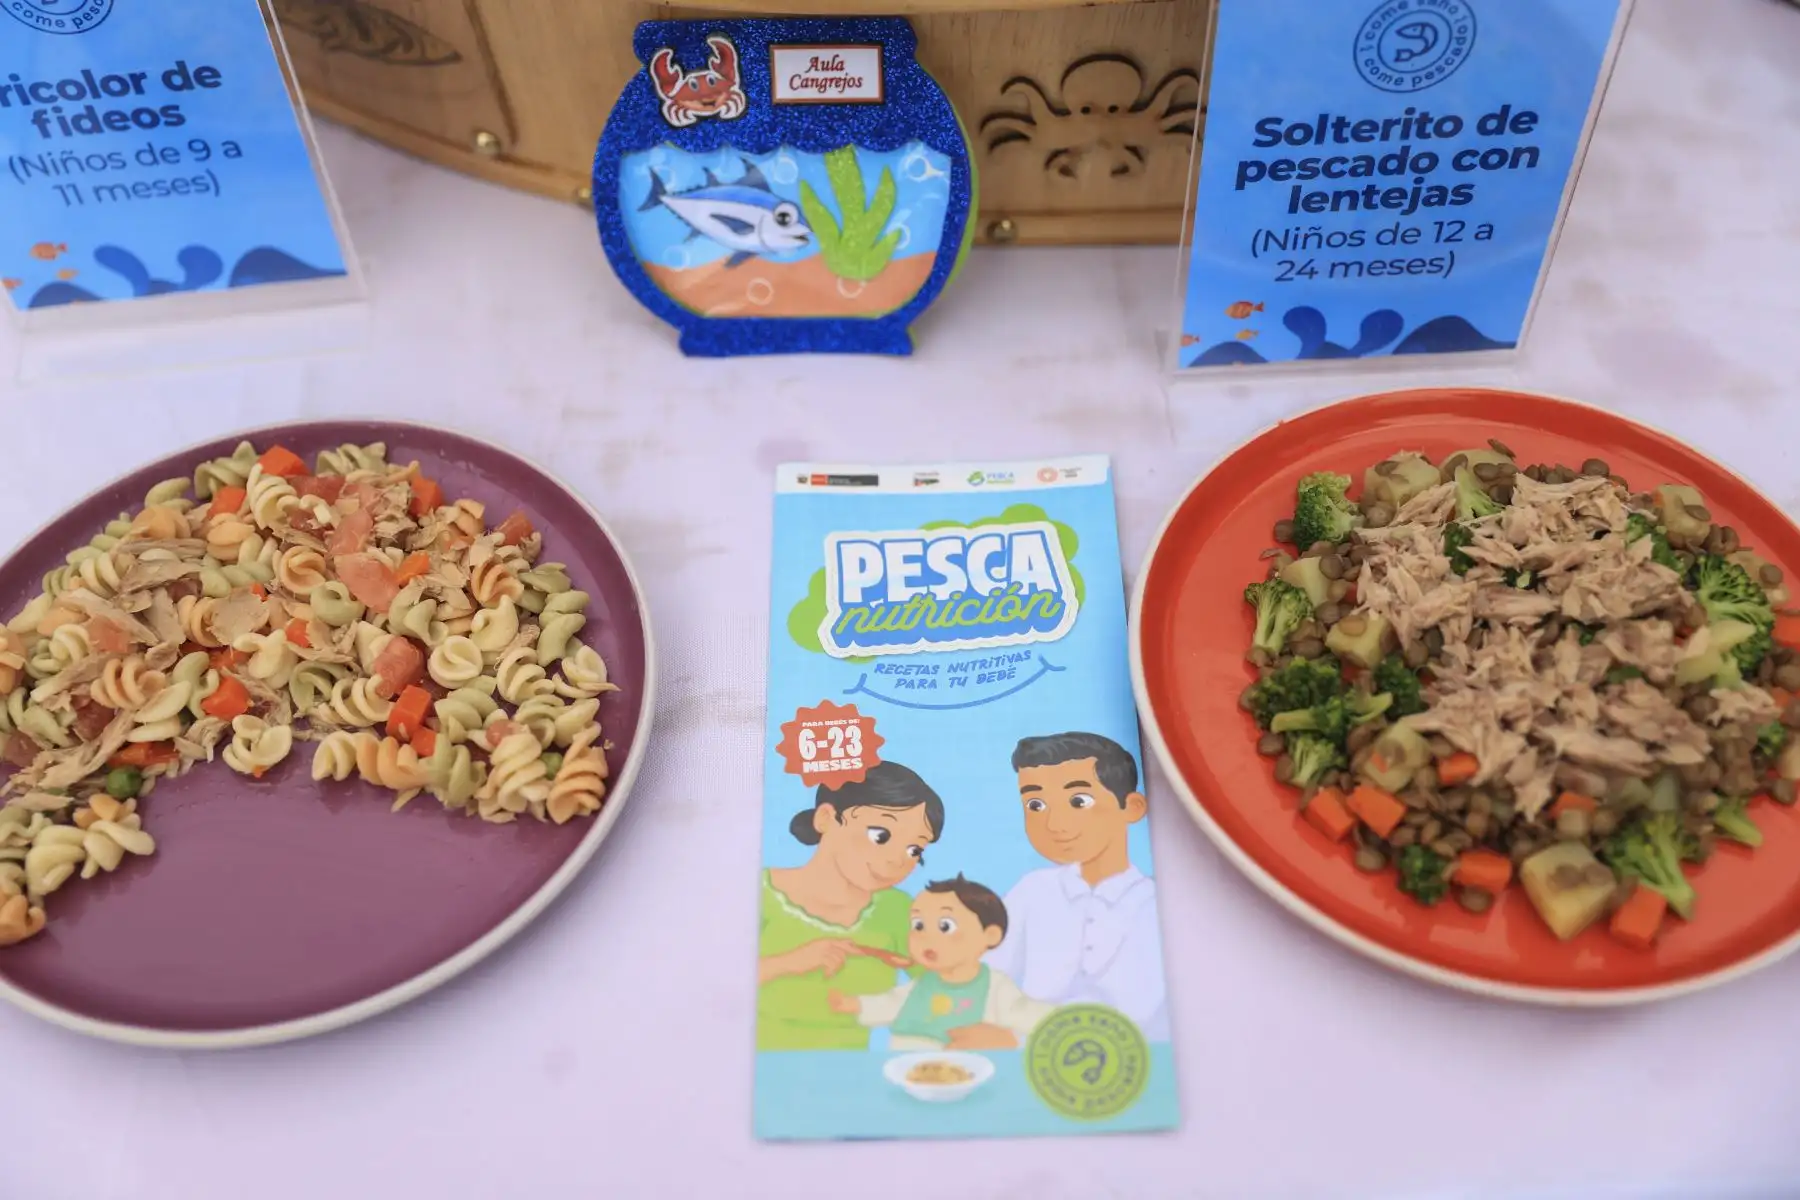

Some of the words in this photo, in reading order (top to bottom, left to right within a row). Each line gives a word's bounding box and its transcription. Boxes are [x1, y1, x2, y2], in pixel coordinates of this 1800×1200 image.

[161, 60, 222, 92] de
[804, 53, 846, 73] Aula
[789, 72, 864, 94] Cangrejos
[31, 104, 186, 139] fideos
[1252, 107, 1464, 148] Solterito
[1476, 104, 1539, 137] de
[8, 150, 128, 185] (Niños
[135, 142, 182, 167] de
[188, 138, 212, 162] 9
[221, 140, 244, 159] a
[1235, 145, 1440, 190] pescado
[1452, 145, 1541, 172] con
[53, 183, 84, 208] 11
[93, 168, 221, 204] meses)
[1287, 176, 1476, 216] lentejas
[1251, 225, 1366, 258] (Niños
[1375, 221, 1422, 247] de
[1433, 219, 1466, 244] 12
[1473, 222, 1495, 242] a
[1274, 258, 1319, 283] 24
[1328, 250, 1456, 280] meses)
[838, 531, 1061, 604] PESCA
[835, 580, 1062, 635] nutrición
[873, 662, 941, 676] RECETAS
[894, 677, 938, 690] PARA
[949, 675, 968, 689] TU
[798, 725, 863, 760] 6-23
[802, 757, 864, 773] MESES
